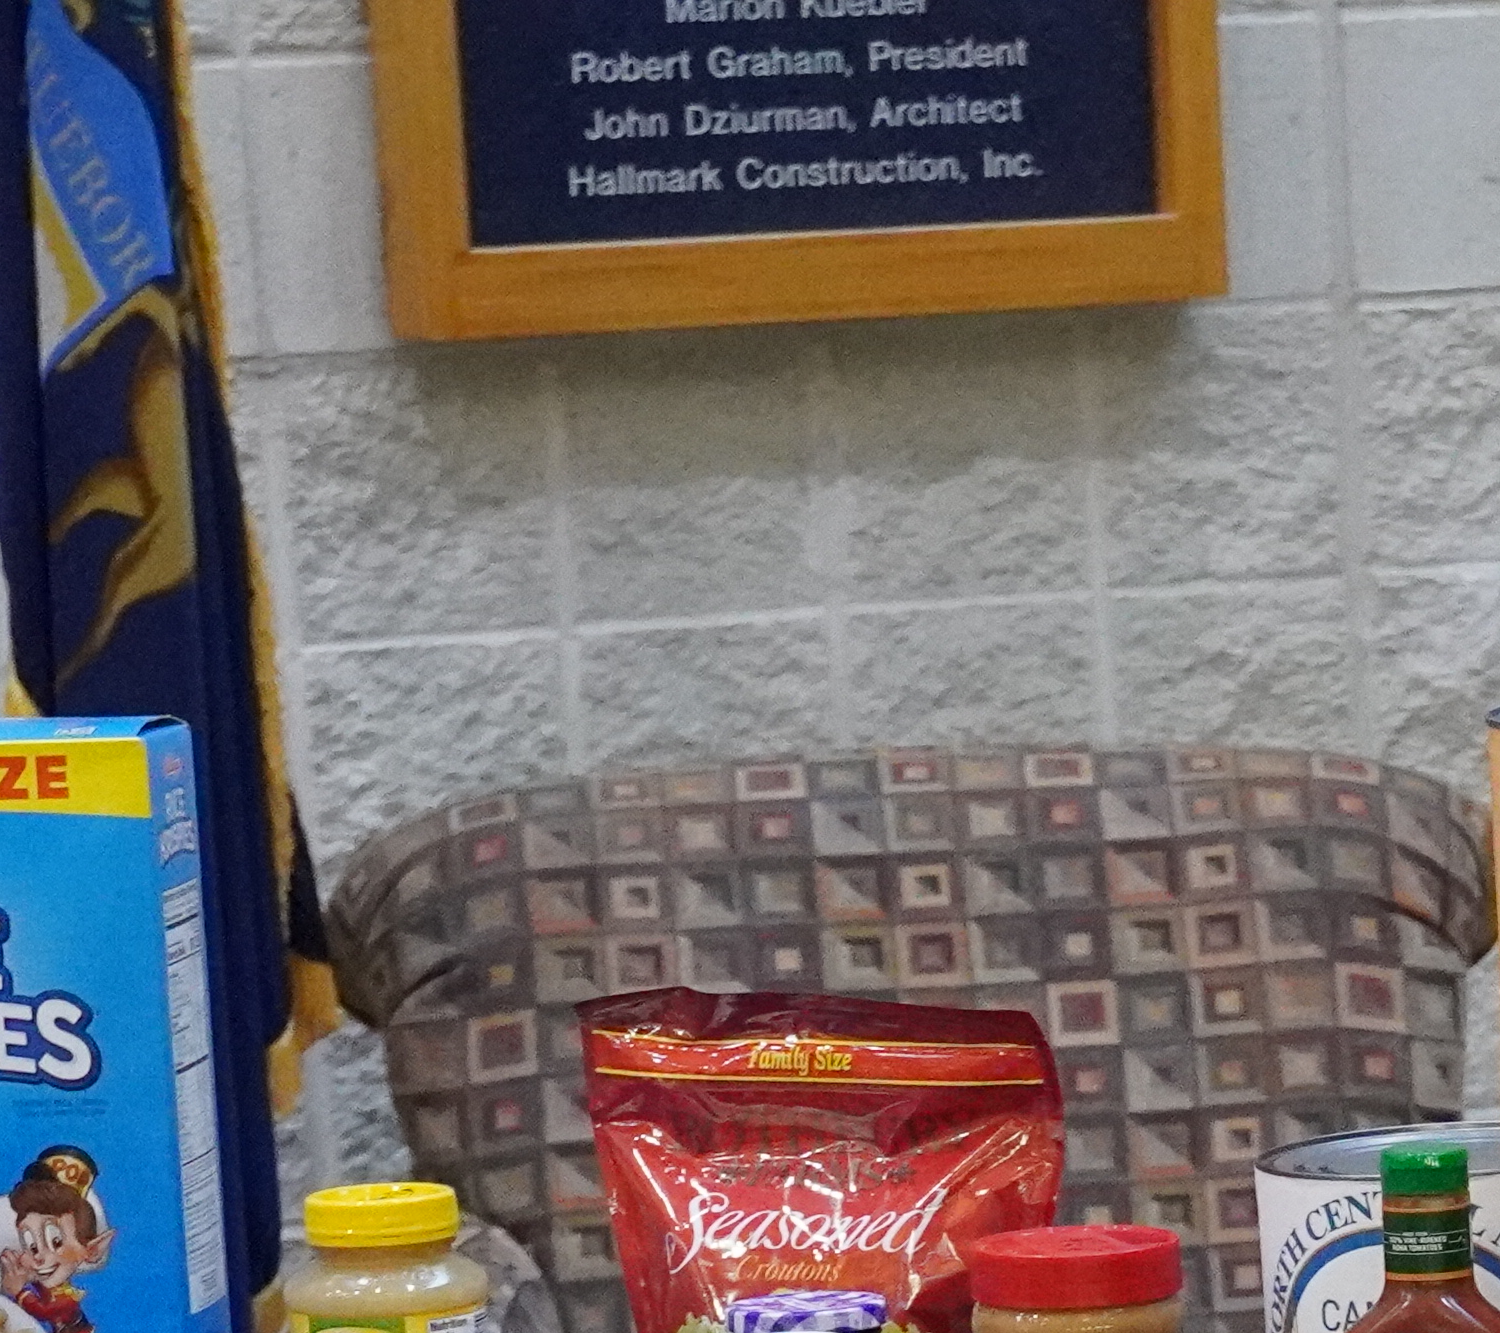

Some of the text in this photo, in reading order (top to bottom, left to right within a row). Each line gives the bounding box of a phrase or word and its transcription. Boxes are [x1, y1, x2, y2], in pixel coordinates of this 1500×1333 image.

[571, 38, 1029, 84] Robert Graham, President
[584, 95, 1022, 141] John Dziurman, Architect
[568, 148, 1044, 198] Hallmark Construction, Inc.
[749, 1046, 852, 1076] Family Size
[670, 1188, 946, 1274] Seasoned
[736, 1255, 842, 1283] Croutons
